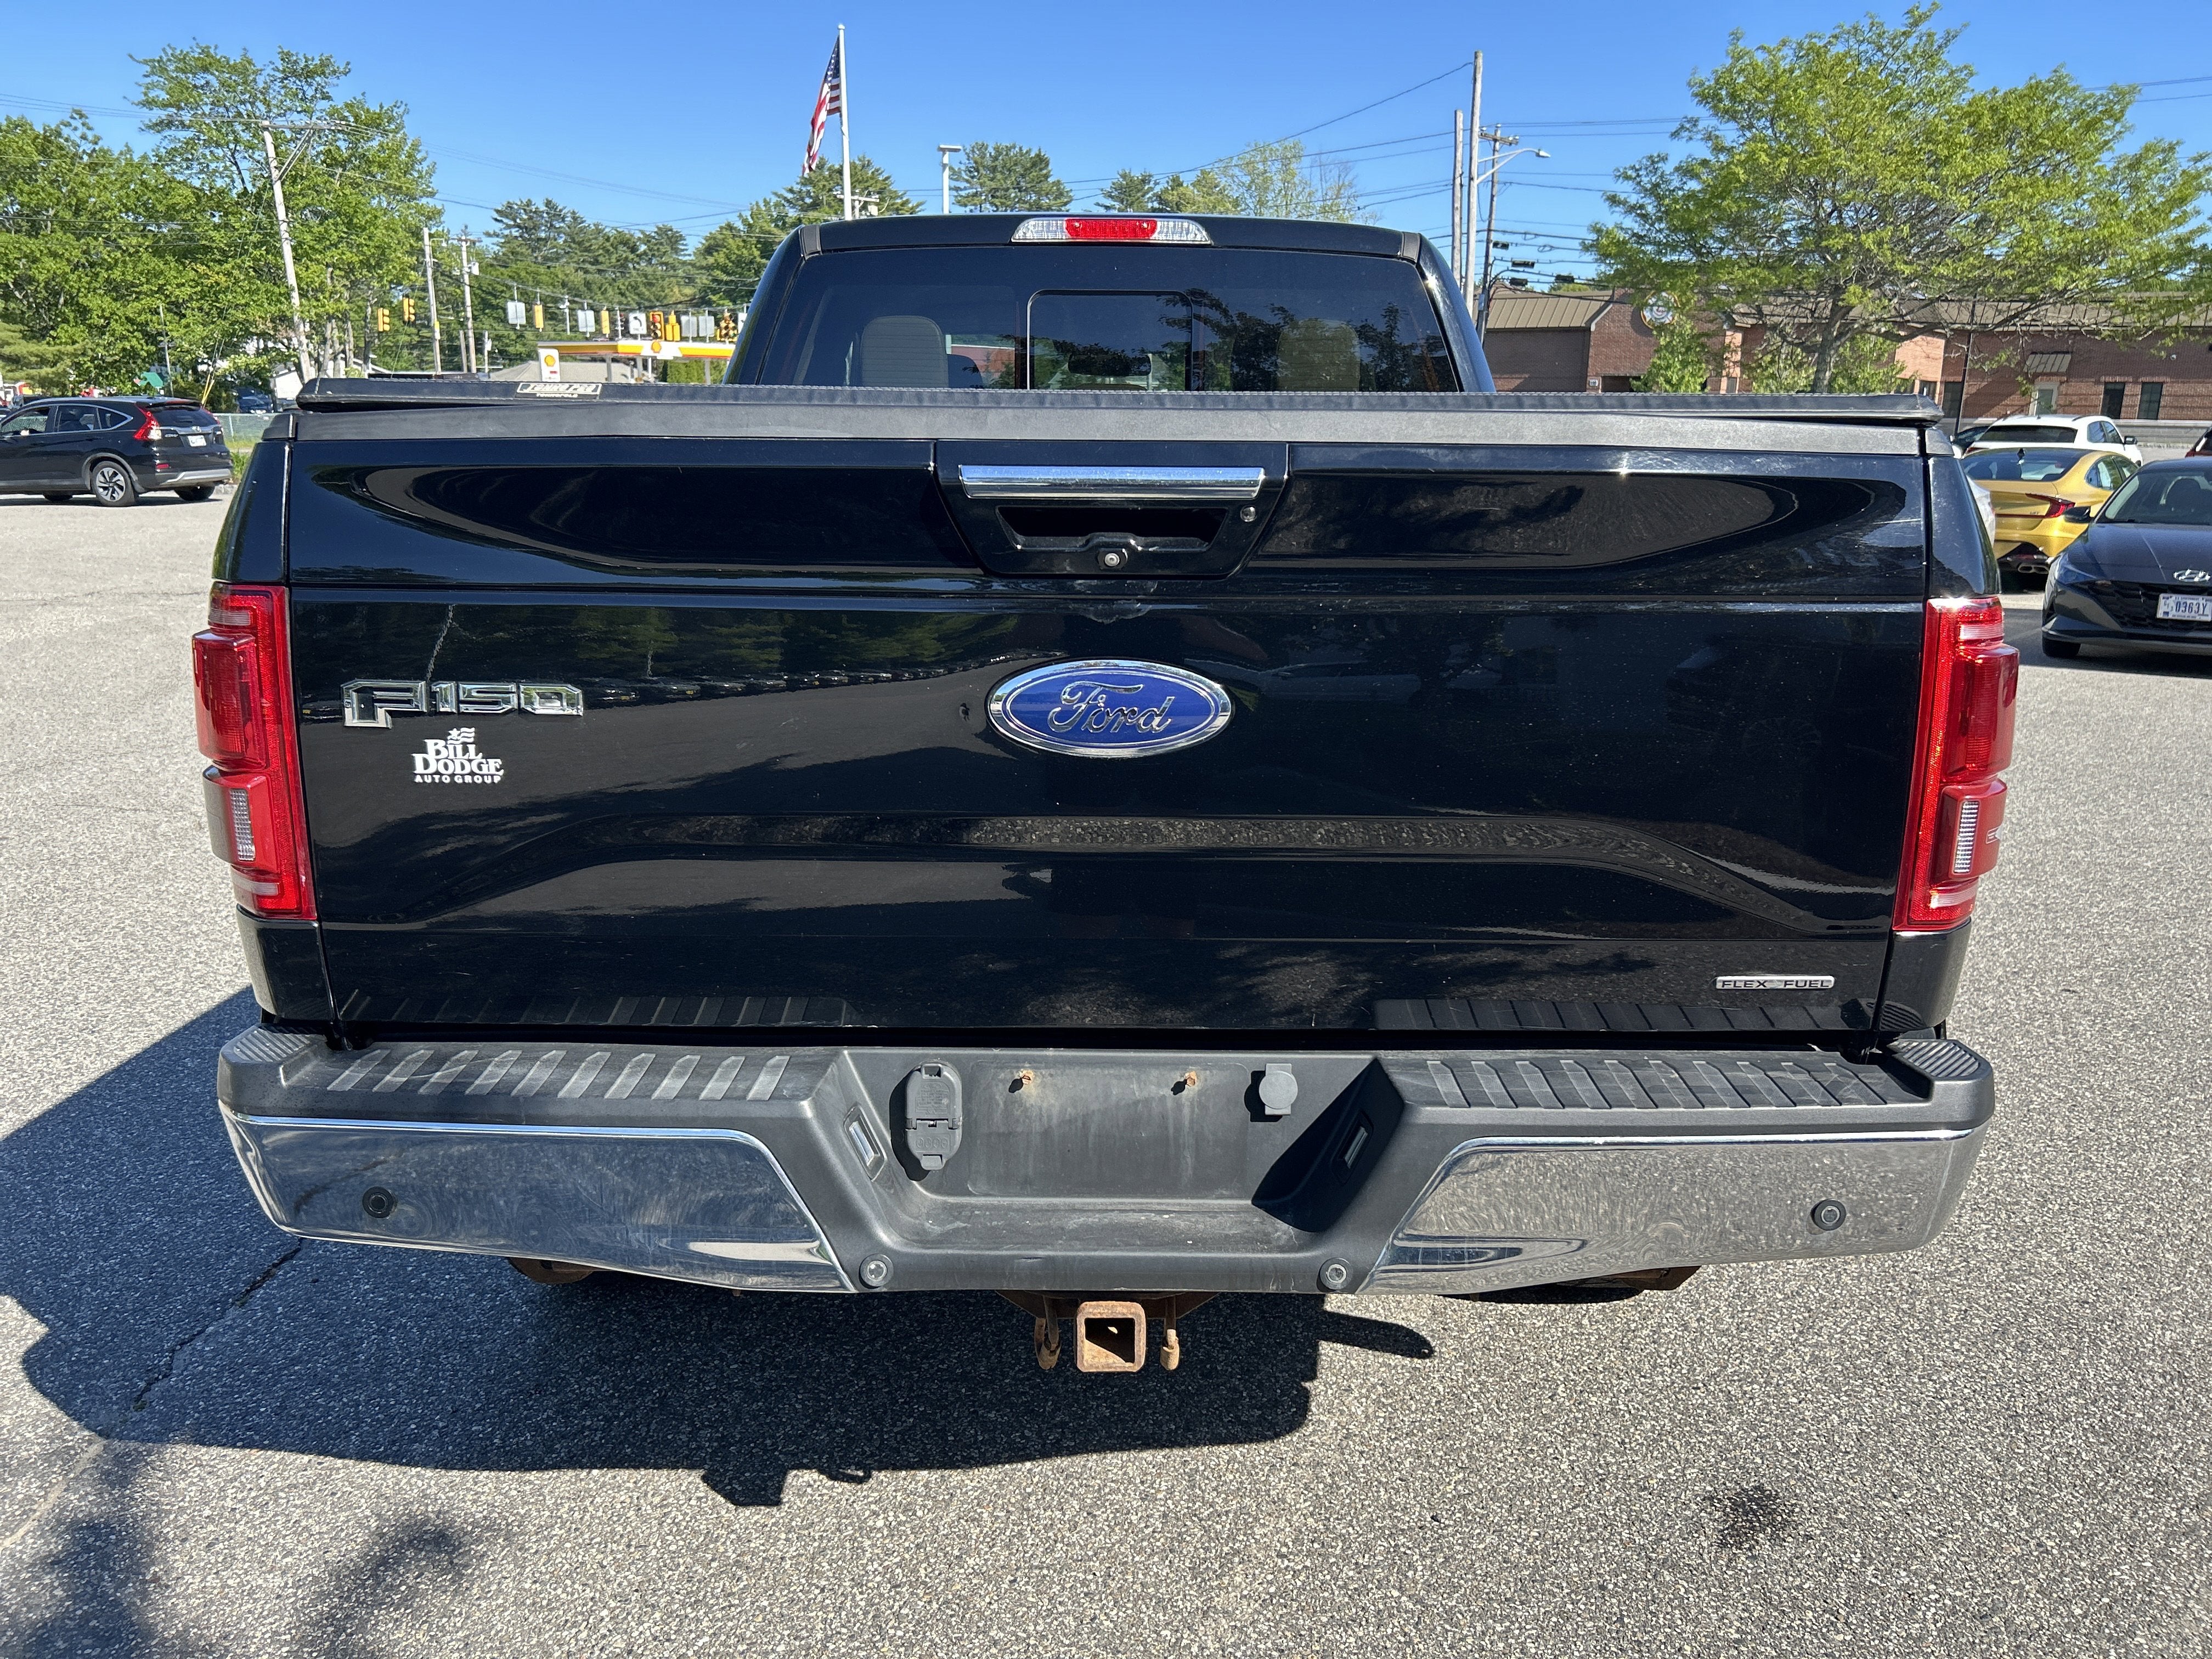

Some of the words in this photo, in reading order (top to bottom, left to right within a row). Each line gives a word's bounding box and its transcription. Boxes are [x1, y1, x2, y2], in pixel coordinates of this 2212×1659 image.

[1047, 680, 1176, 733] Ford
[425, 739, 483, 759] BILL
[412, 753, 504, 776] DODGE
[414, 775, 450, 783] AUTO
[454, 775, 501, 783] GROUP
[1722, 980, 1768, 988] FLEX
